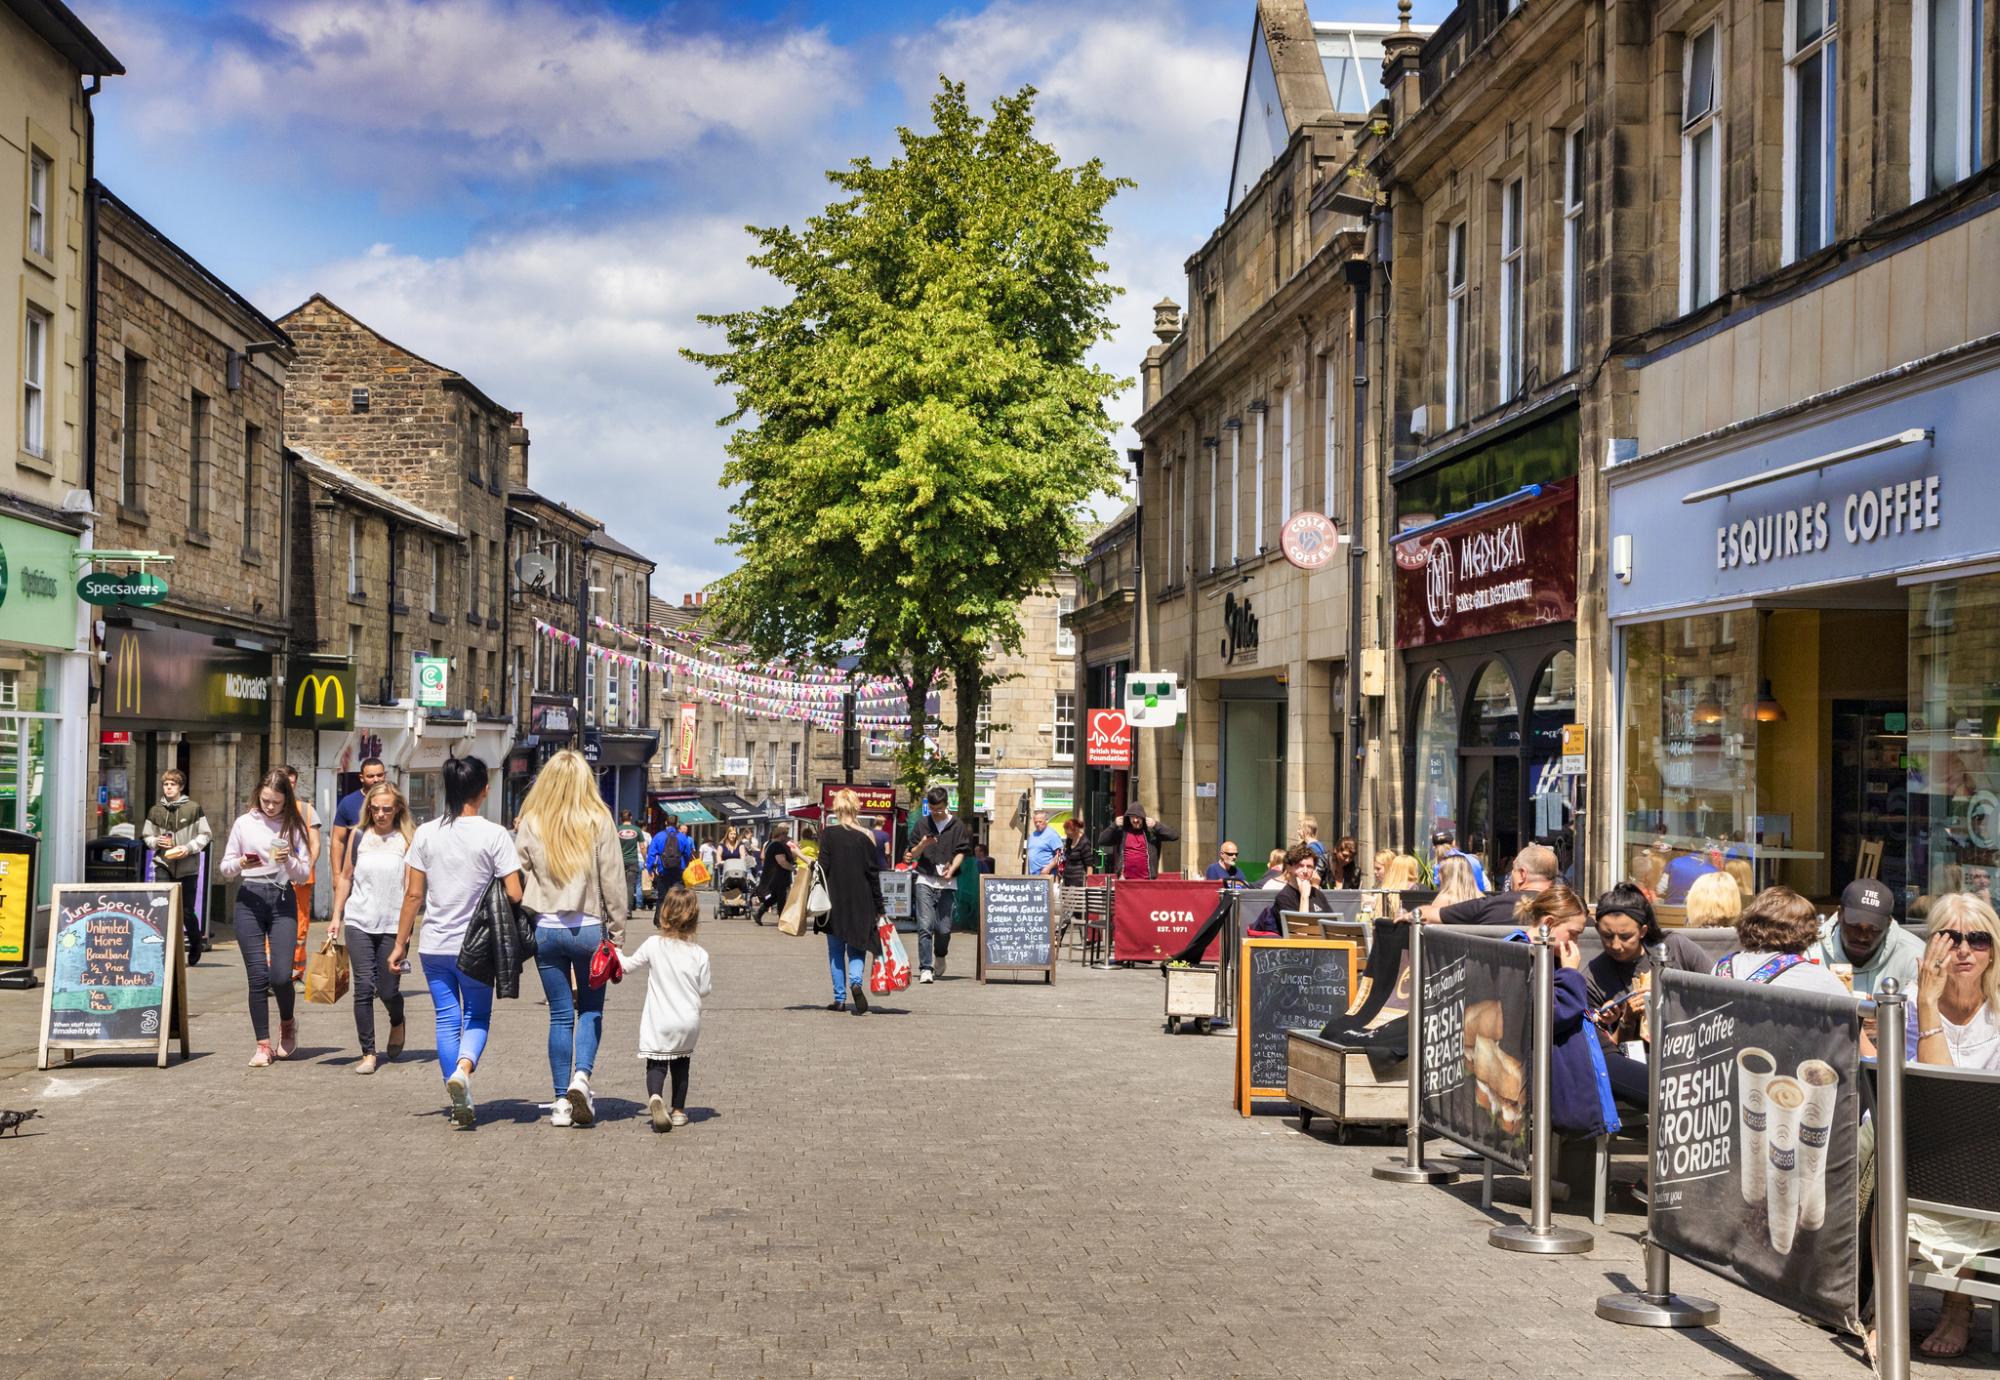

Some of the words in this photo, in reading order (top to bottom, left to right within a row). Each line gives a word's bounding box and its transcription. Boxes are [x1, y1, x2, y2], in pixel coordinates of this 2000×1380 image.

[1291, 517, 1325, 532] COSTA
[1717, 502, 1829, 569] ESQUIRES
[1844, 475, 1941, 543] COFFEE
[1290, 545, 1331, 562] COFFEE
[1461, 522, 1525, 581] MEDUSA
[86, 582, 159, 597] Specsavers
[225, 673, 267, 700] McDonald's
[872, 792, 892, 800] Burger
[866, 800, 891, 808] £4.00
[989, 893, 1029, 902] CHICKEN
[1864, 889, 1878, 899] THE
[1861, 897, 1880, 907] CLUB
[62, 901, 92, 923] June
[1016, 914, 1044, 922] SAUCE
[1150, 911, 1194, 923] COSTA
[85, 919, 130, 934] Unlimited
[94, 935, 123, 946] Home
[1025, 933, 1043, 941] RICE
[86, 948, 129, 960] Broadband
[105, 962, 124, 972] Price
[80, 974, 95, 985] For
[102, 975, 110, 985] 6
[116, 971, 154, 985] Months?
[1280, 973, 1312, 985] JACKET
[90, 990, 104, 1000] Yes
[1308, 1002, 1333, 1014] DELI
[53, 1028, 101, 1036] #makeitright
[1662, 1034, 1696, 1060] Every
[1698, 1014, 1735, 1048] Coffee
[1659, 1059, 1734, 1111] FRESHLY
[1658, 1100, 1732, 1148] GROUND
[1673, 1136, 1731, 1174] ORDER
[1670, 1190, 1683, 1205] you
